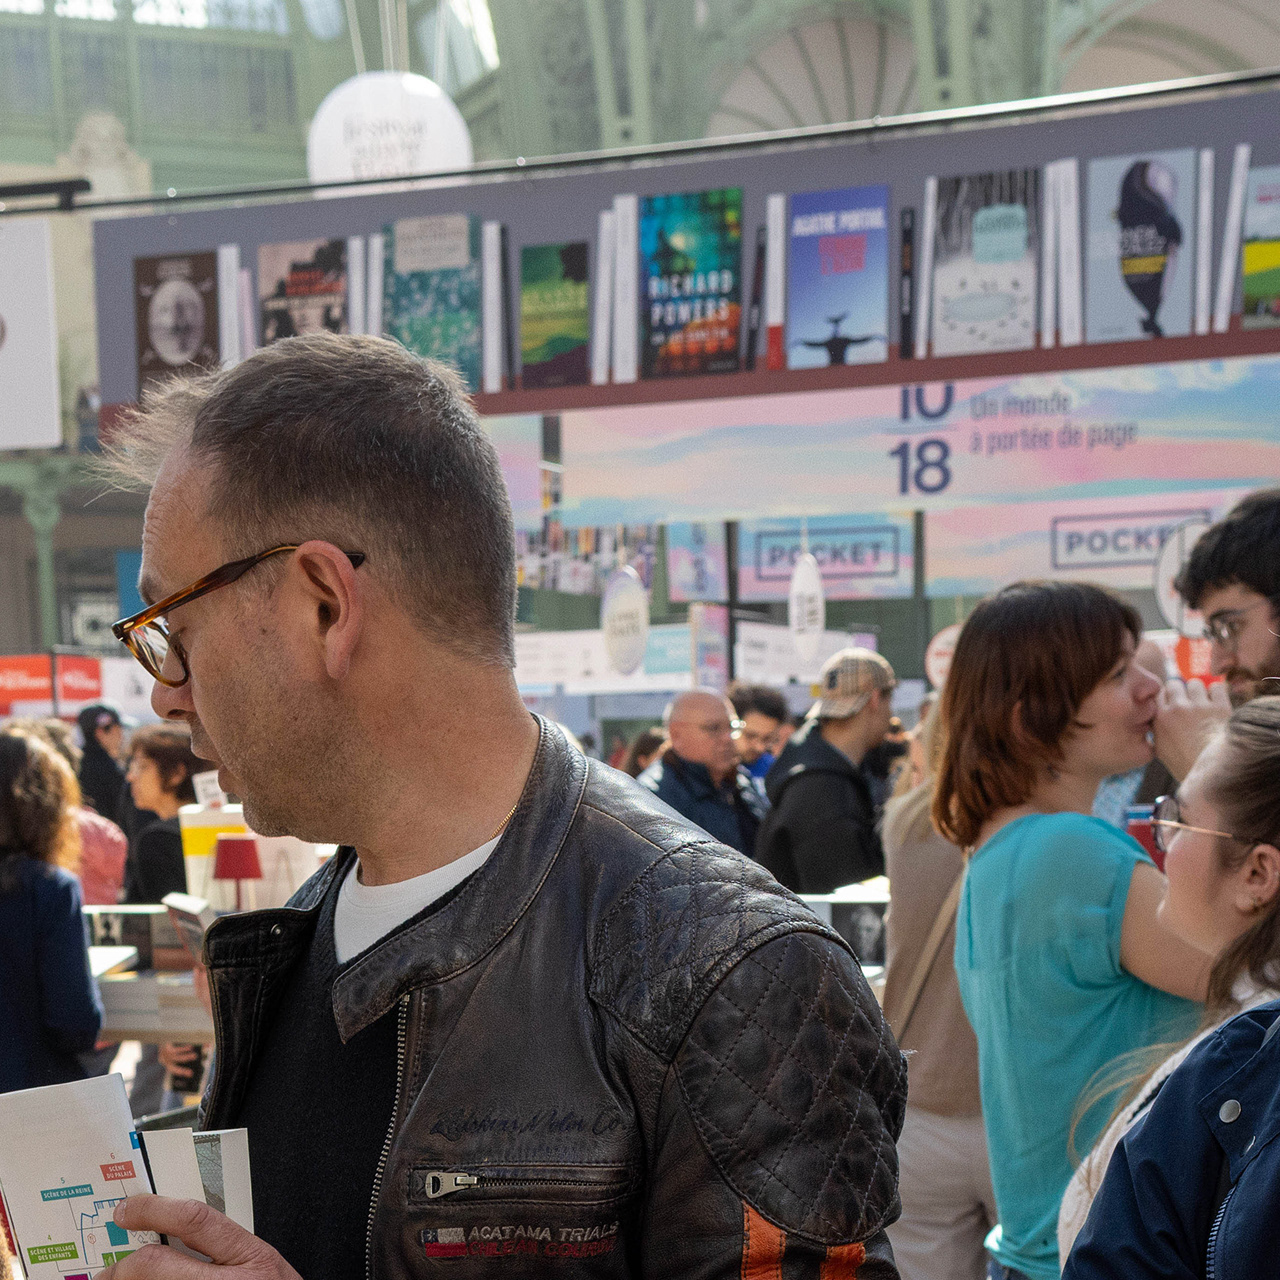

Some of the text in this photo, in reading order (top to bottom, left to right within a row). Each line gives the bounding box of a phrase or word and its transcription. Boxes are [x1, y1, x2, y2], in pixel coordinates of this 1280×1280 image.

[648, 269, 732, 299] RICHARD
[651, 298, 730, 327] POWERS
[1001, 391, 1069, 416] monde
[986, 427, 1053, 457] portée
[1057, 423, 1081, 449] de
[1086, 423, 1138, 451] page
[888, 439, 952, 495] 18
[106, 1170, 133, 1180] DU PALAIS
[43, 1186, 92, 1199] SCÈNE DE REINE
[559, 1220, 620, 1242] TRIALS
[29, 1247, 47, 1256] SCÈNE
[48, 1251, 72, 1260] ENFANTS
